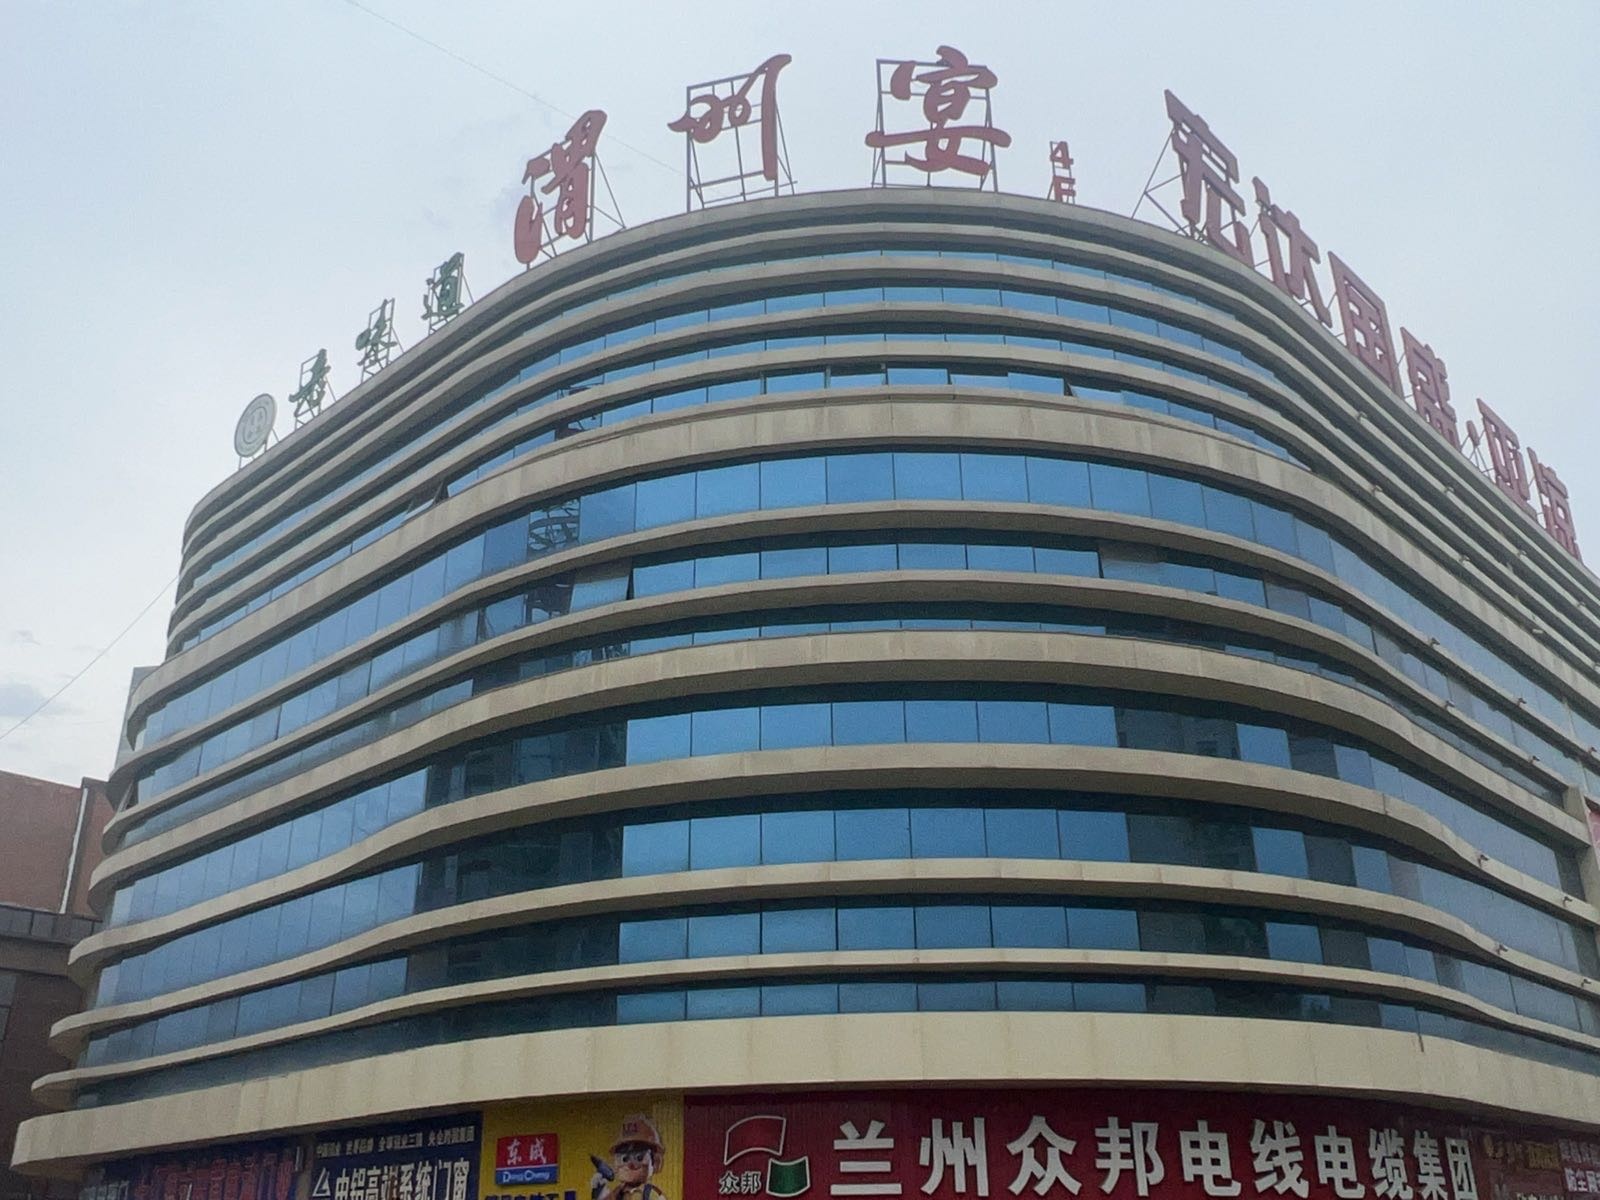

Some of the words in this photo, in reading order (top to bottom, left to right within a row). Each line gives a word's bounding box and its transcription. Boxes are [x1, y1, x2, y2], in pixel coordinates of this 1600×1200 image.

[1051, 141, 1076, 203] 4F
[719, 1170, 762, 1195] 众邦
[830, 1115, 1479, 1200] 兰州众邦电线电缆集团
